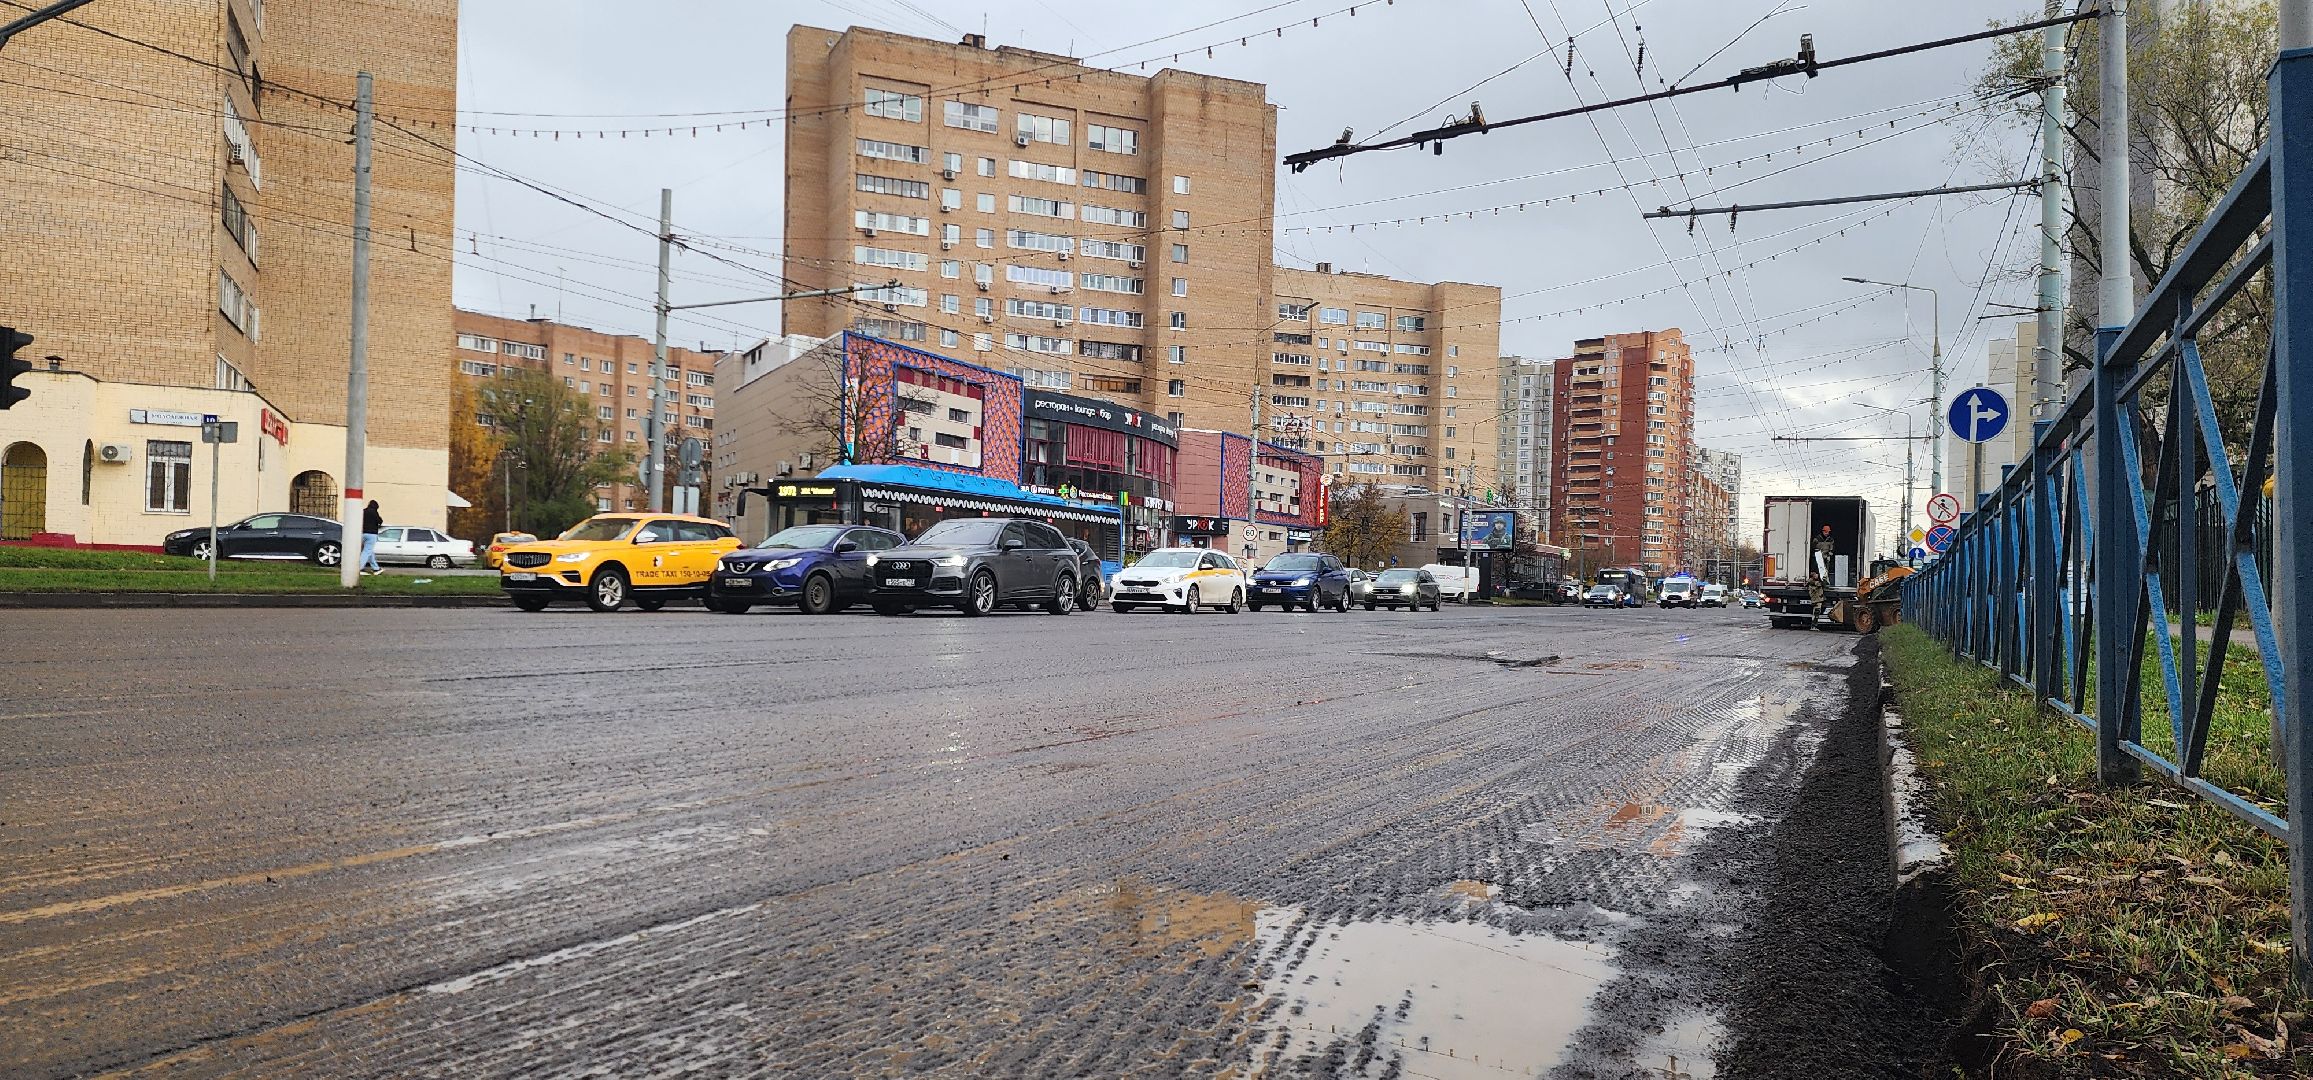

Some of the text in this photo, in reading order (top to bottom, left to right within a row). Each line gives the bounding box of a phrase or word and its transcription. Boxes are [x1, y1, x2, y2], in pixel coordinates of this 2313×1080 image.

[1035, 400, 1070, 412] ресторан
[1100, 408, 1112, 421] бар
[1186, 518, 1215, 531] УРЮК
[1246, 529, 1255, 537] 60
[1869, 572, 1889, 589] CASE
